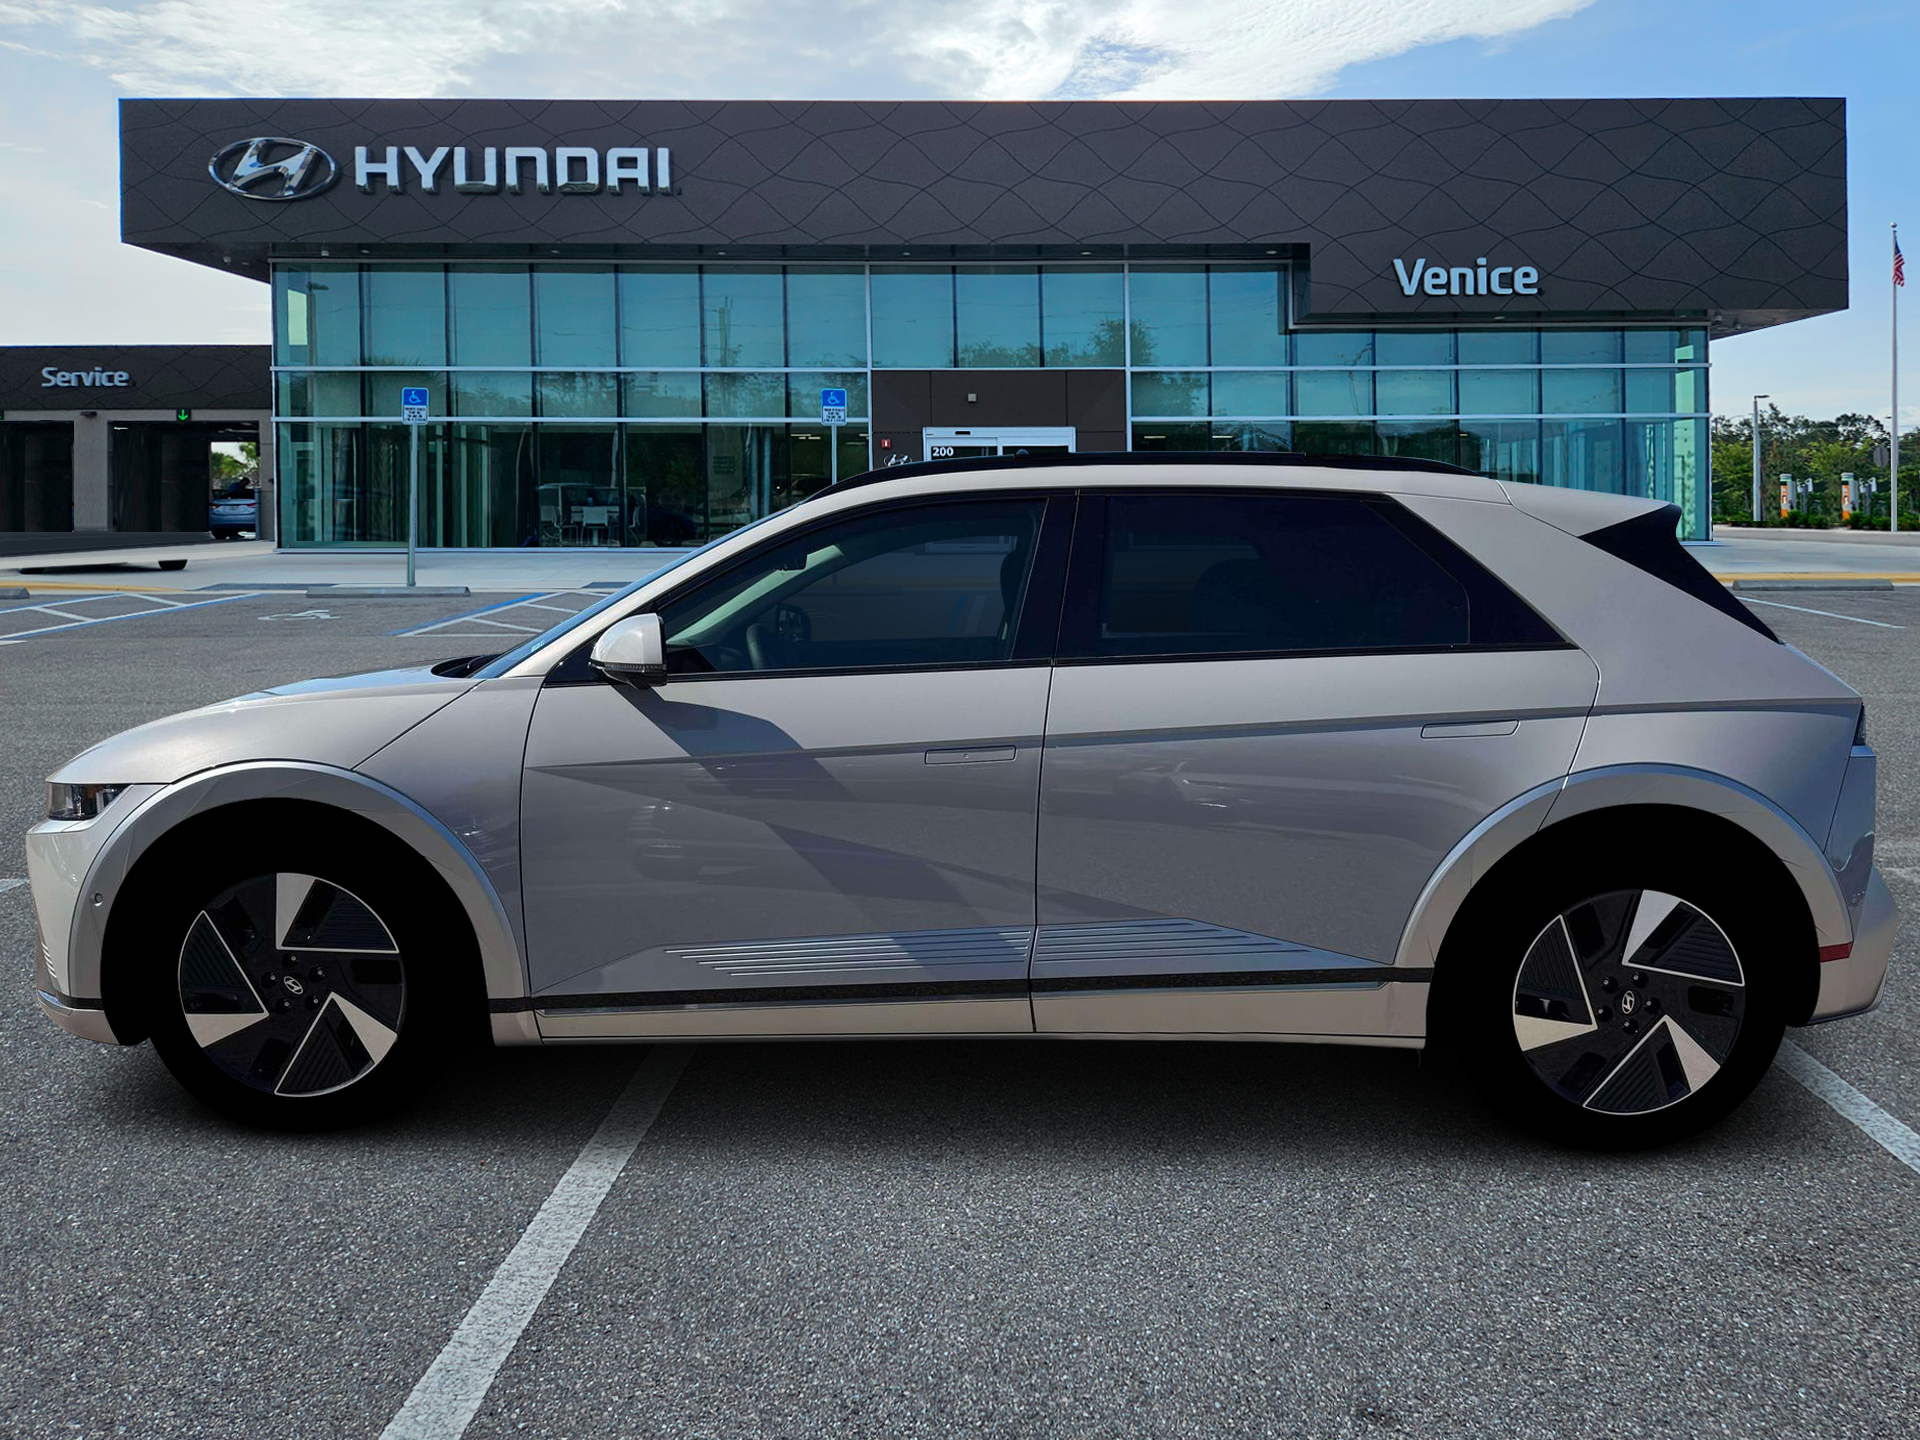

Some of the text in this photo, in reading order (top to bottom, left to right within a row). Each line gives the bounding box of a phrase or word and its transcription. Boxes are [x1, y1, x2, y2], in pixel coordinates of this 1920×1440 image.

[355, 146, 671, 194] HYUNDAI
[1393, 257, 1539, 296] Venice
[41, 366, 130, 387] Service
[932, 446, 954, 457] 200
